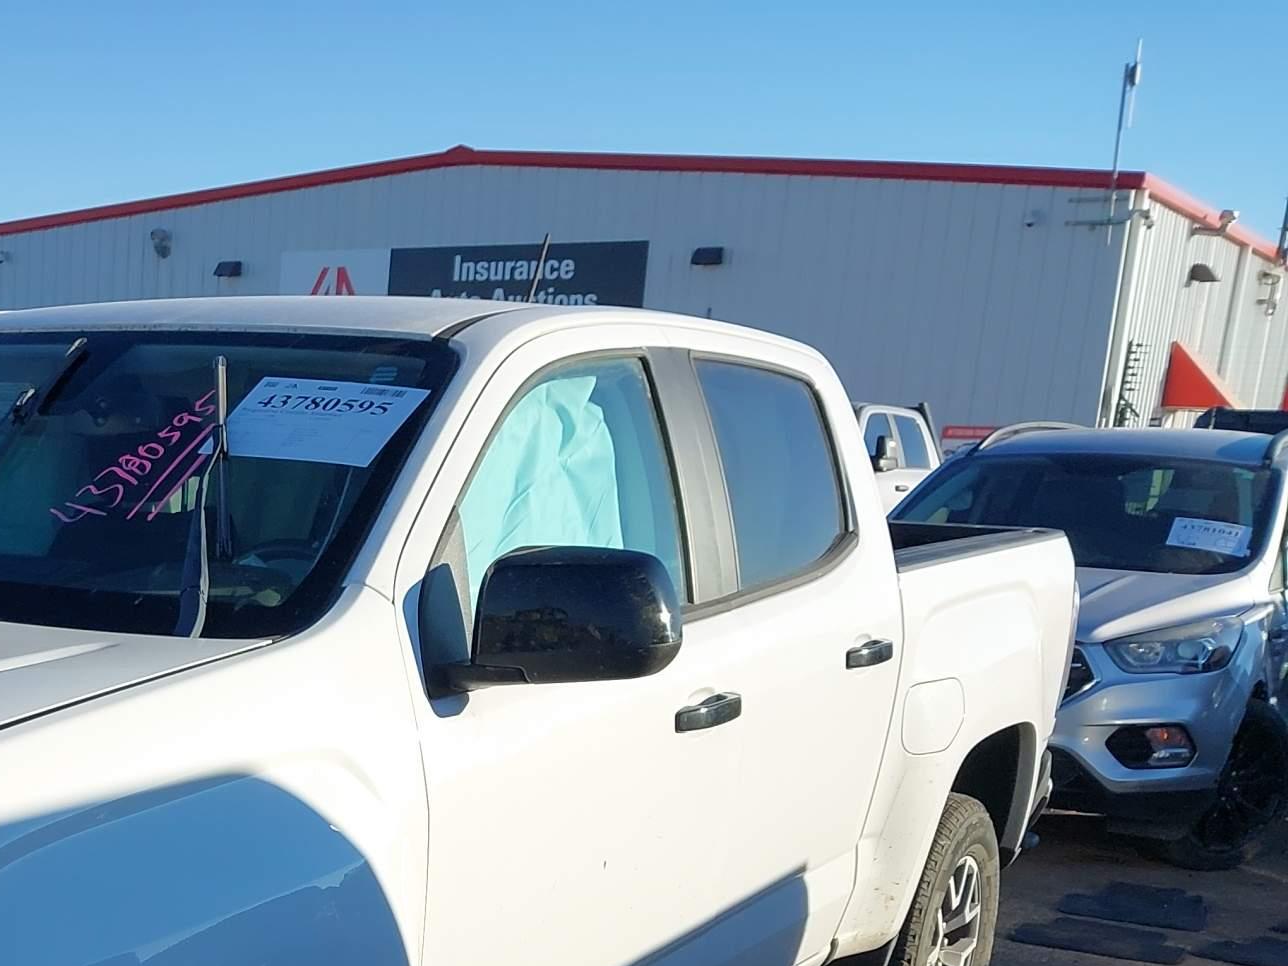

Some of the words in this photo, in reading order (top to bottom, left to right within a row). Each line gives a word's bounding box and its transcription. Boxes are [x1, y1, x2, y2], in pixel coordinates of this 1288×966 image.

[453, 255, 575, 282] Insurance
[492, 287, 598, 306] Ations
[257, 393, 394, 416] 43780595
[49, 389, 216, 523] 43780595
